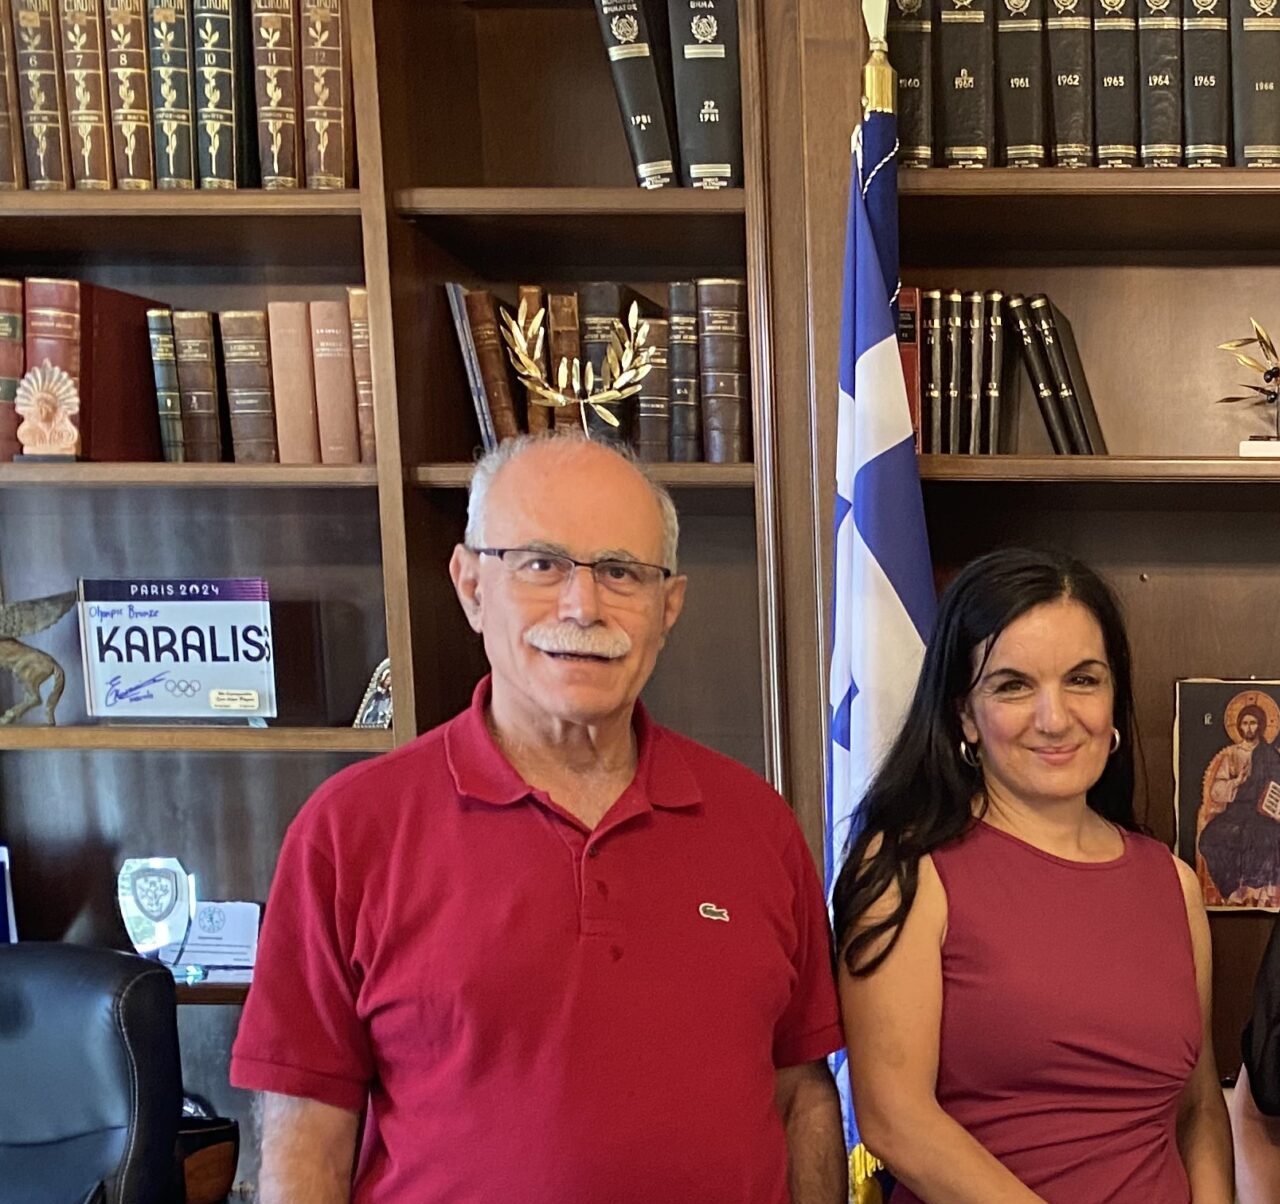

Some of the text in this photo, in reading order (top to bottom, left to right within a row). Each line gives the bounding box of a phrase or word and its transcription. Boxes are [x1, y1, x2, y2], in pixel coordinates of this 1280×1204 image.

[29, 55, 38, 66] 6
[76, 55, 84, 66] 7
[119, 54, 128, 66] 8
[162, 53, 170, 64] 9
[204, 52, 217, 65] 10
[268, 52, 277, 65] 11
[314, 52, 326, 63] 12
[1010, 77, 1030, 88] 1961
[1057, 75, 1080, 86] 1962
[1103, 76, 1125, 87] 1963
[1148, 75, 1170, 87] 1964
[1194, 75, 1216, 87] 1965
[130, 584, 219, 596] PARIS 2024
[96, 624, 266, 663] KARALIS
